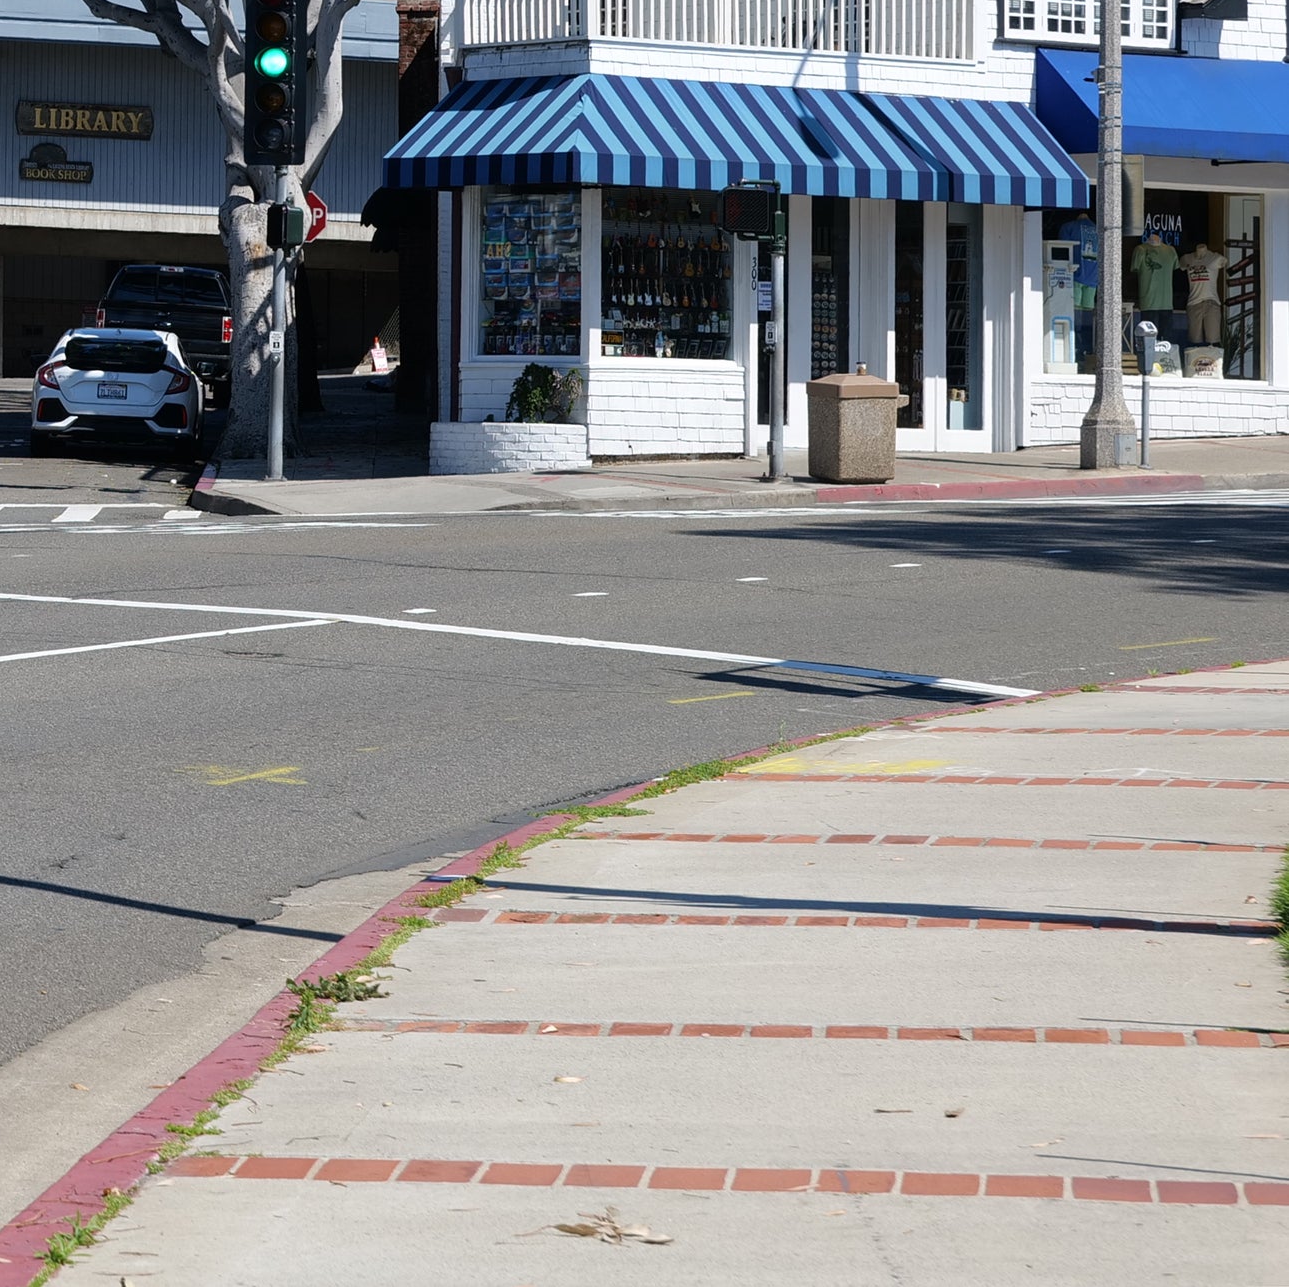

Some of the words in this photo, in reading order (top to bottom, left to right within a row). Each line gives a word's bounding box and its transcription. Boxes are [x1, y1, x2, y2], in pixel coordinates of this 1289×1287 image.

[33, 107, 144, 133] LIBRARY
[25, 167, 56, 179] BOOK
[57, 169, 87, 181] SHOP
